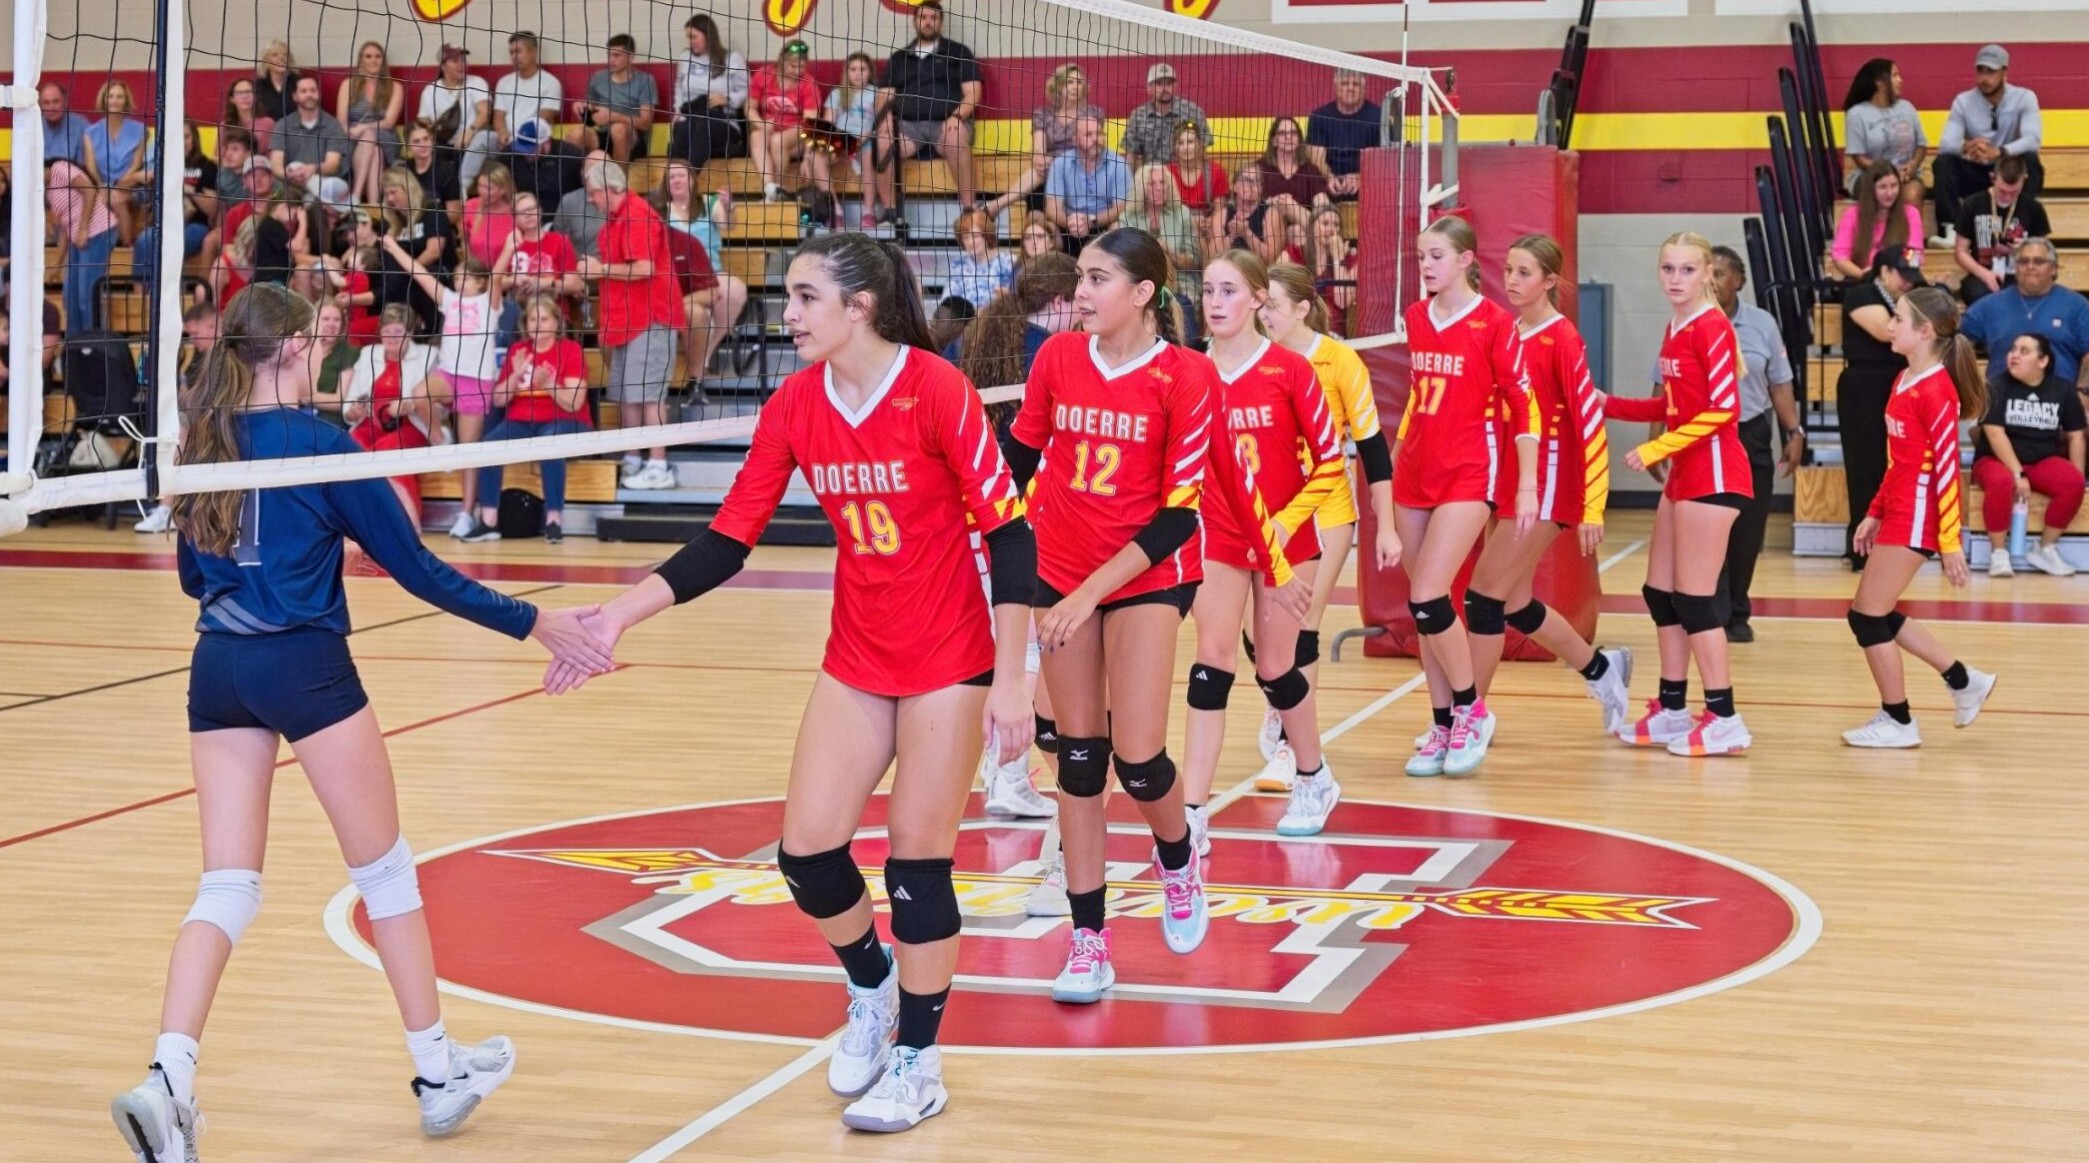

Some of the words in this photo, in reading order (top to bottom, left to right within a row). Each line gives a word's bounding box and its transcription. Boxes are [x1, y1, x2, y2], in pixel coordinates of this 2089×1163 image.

[1417, 376, 1447, 416] 17
[2006, 398, 2060, 417] LEGACY
[1055, 403, 1149, 442] DOERRE
[1231, 405, 1274, 430] RRE
[812, 460, 909, 495] DOERRE
[1070, 441, 1120, 496] 12
[841, 500, 901, 555] 19
